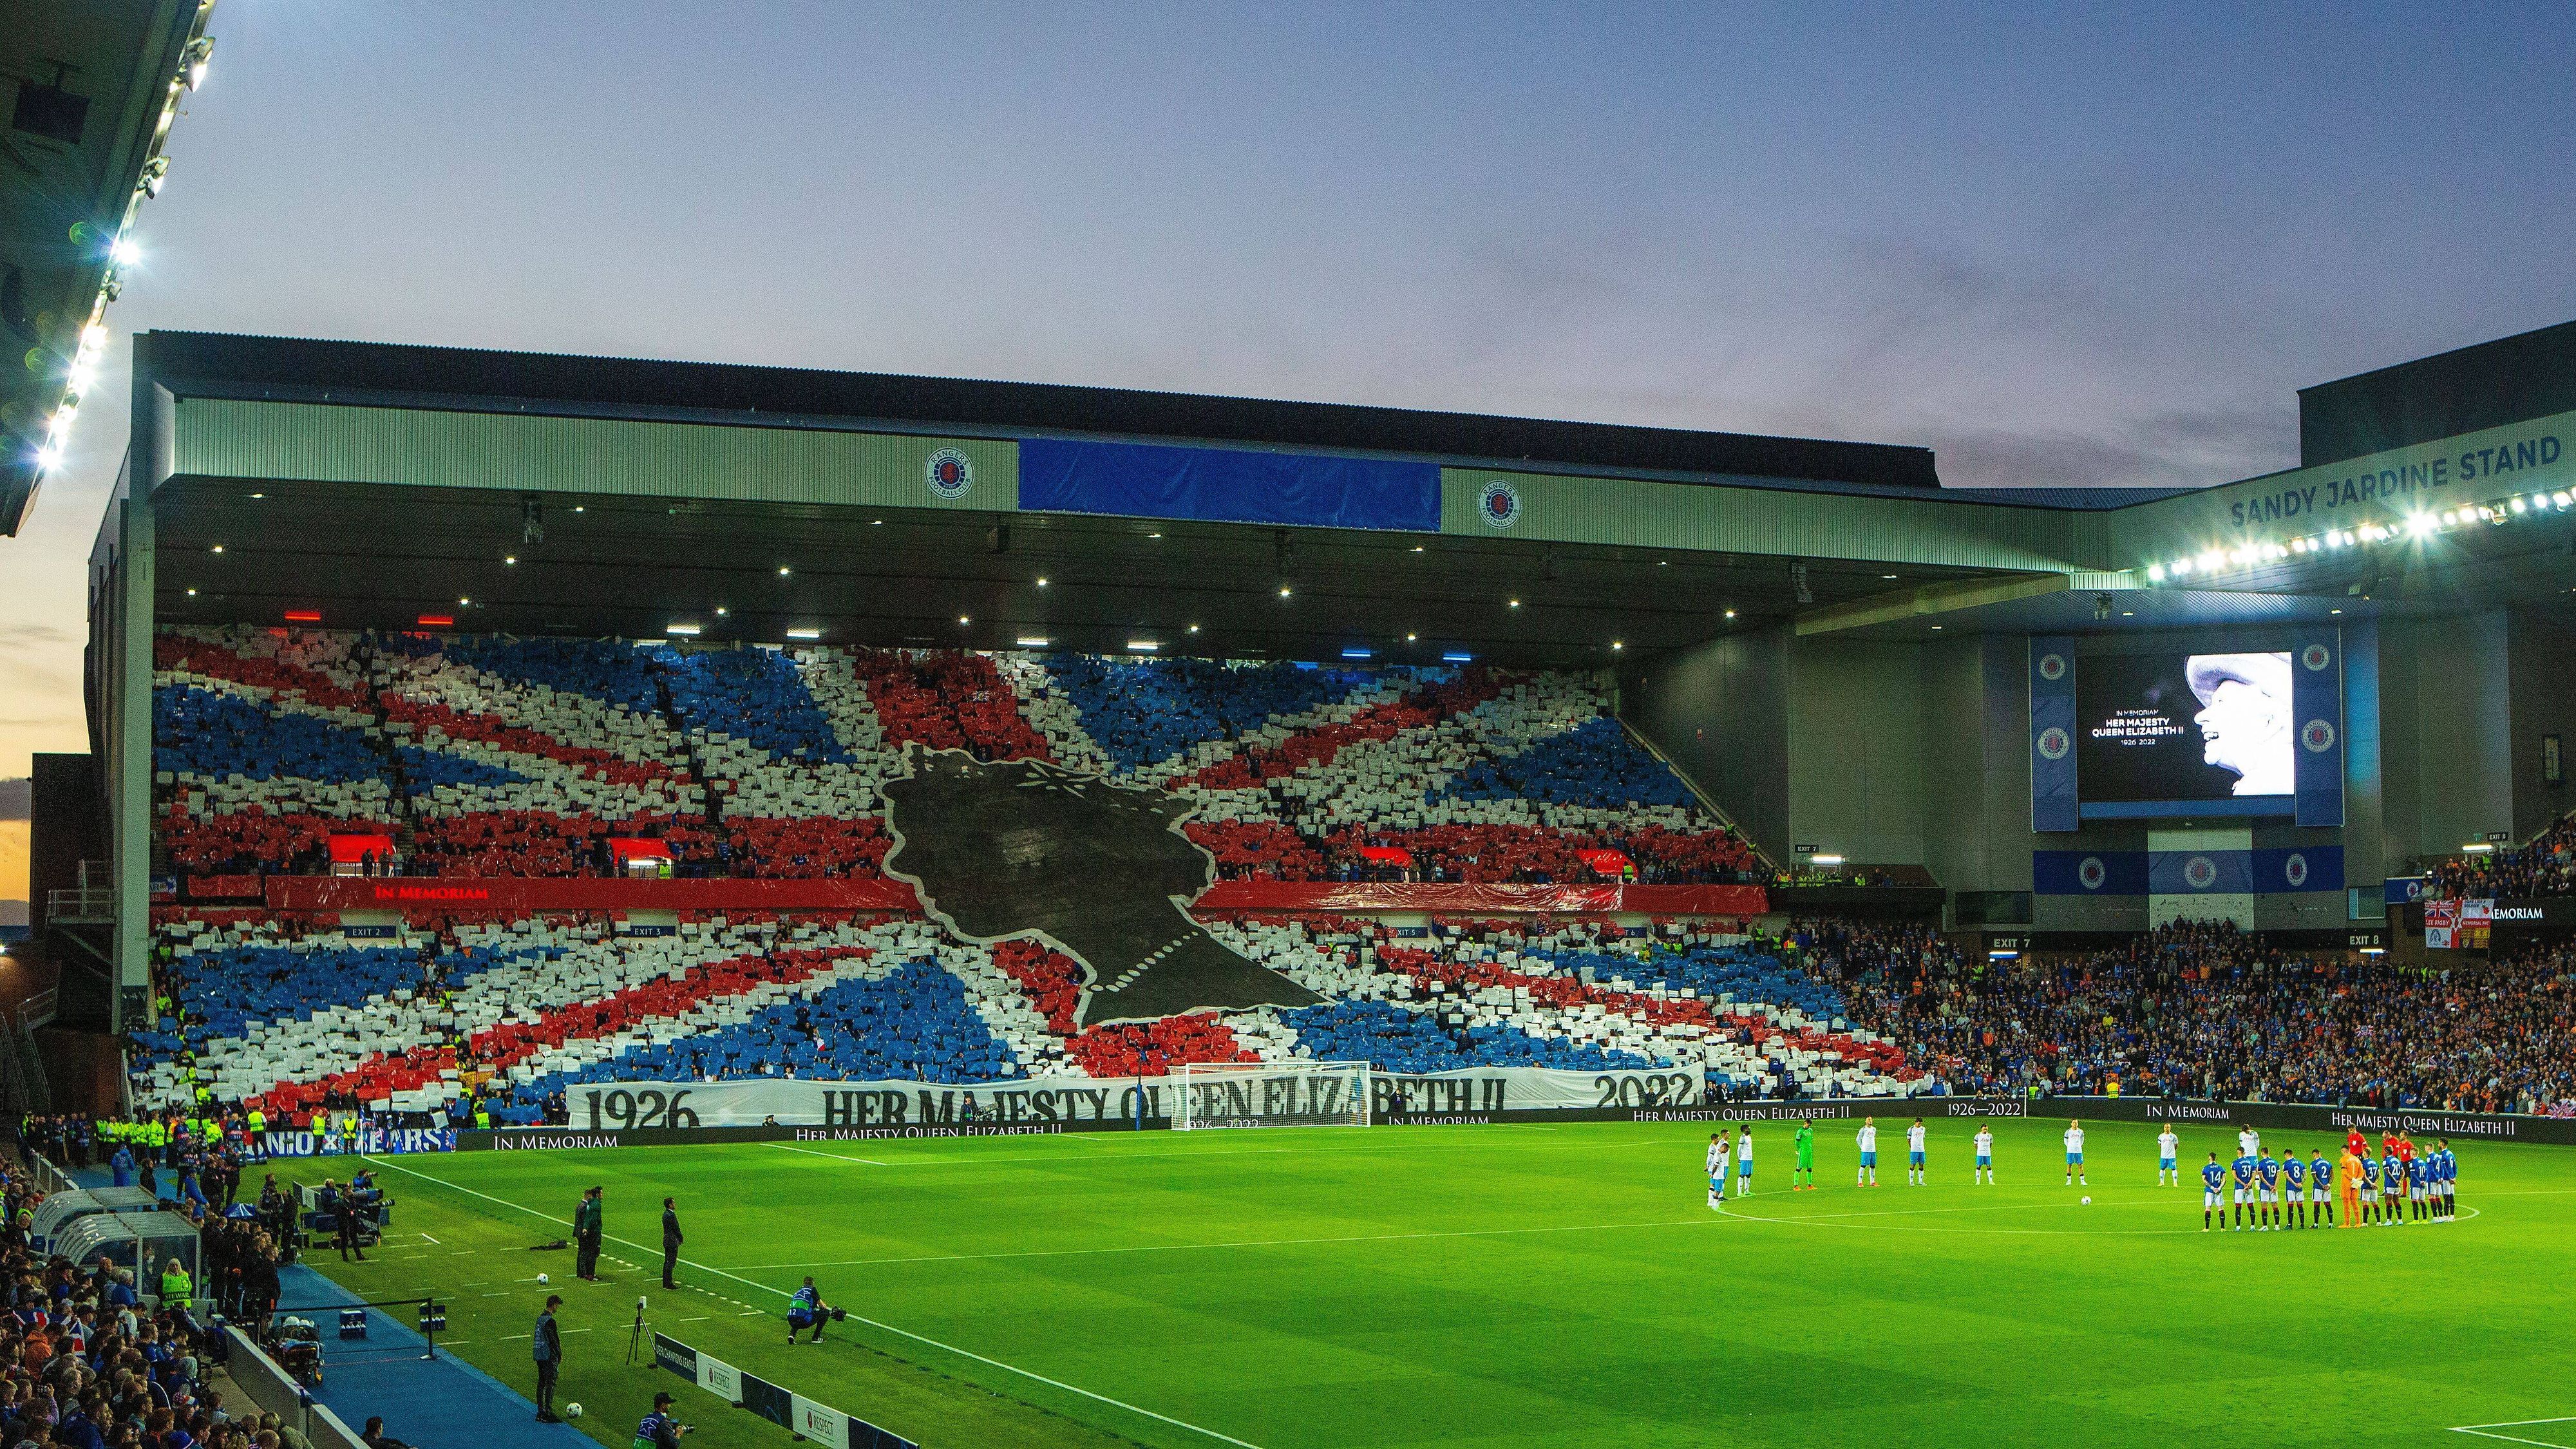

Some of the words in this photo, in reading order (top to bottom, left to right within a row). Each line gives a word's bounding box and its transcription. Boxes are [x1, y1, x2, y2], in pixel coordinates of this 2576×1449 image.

[931, 450, 969, 466] RANGERS
[928, 476, 958, 496] FOOTBALL
[958, 478, 971, 493] CLUB
[2231, 486, 2316, 528] SANDY
[2326, 459, 2448, 509] JARDINE
[2459, 435, 2561, 481] STAND
[1483, 482, 1516, 497] RANGERS
[1481, 507, 1507, 526] FOOTBALL
[1508, 509, 1519, 523] CLUB
[2106, 719, 2125, 728] HER
[2126, 717, 2170, 727] MAJESTY
[2092, 728, 2125, 738] QUEEN
[2126, 726, 2177, 735] ELIZABETH
[2178, 726, 2184, 735] II
[375, 885, 394, 898] IN
[399, 886, 488, 899] MEMORIAM
[1994, 938, 2018, 947] EXIT
[2023, 938, 2031, 947] 7
[2349, 935, 2369, 945] EXIT
[2373, 934, 2379, 945] 8
[586, 1089, 701, 1129] 1926
[822, 1089, 909, 1126] HER
[1481, 1077, 1507, 1111] II
[1594, 1073, 1698, 1108] 2022
[1633, 1110, 1663, 1122] HER
[1666, 1108, 1719, 1122] MAJESTY
[1723, 1108, 1766, 1121] QUEEN
[1772, 1106, 1835, 1120] ELIZABETH
[1840, 1106, 1850, 1118] II
[2146, 1104, 2163, 1117] IN
[2168, 1104, 2230, 1120] MEMORIAM
[1388, 1116, 1405, 1126] IN
[2332, 1112, 2352, 1126] HER
[2356, 1113, 2401, 1130] MAJESTY
[2403, 1115, 2440, 1132] QUEEN
[2445, 1117, 2501, 1135] ELIZABETH
[2506, 1121, 2515, 1135] II
[796, 1128, 828, 1142] HER
[835, 1128, 901, 1141] MAJESTY
[494, 1135, 514, 1151] IN
[521, 1135, 618, 1150] MEMORIAM
[2241, 1165, 2251, 1178] 31
[2267, 1165, 2277, 1177] 19
[2293, 1166, 2300, 1179] 8
[2321, 1166, 2328, 1179] 2
[2368, 1166, 2378, 1179] 37
[2392, 1163, 2401, 1176] 20
[2418, 1166, 2425, 1178] 10
[2436, 1162, 2441, 1172] 4
[2210, 1171, 2222, 1184] 14
[714, 1370, 730, 1389] RESPECT
[813, 1415, 834, 1436] RESPECT
